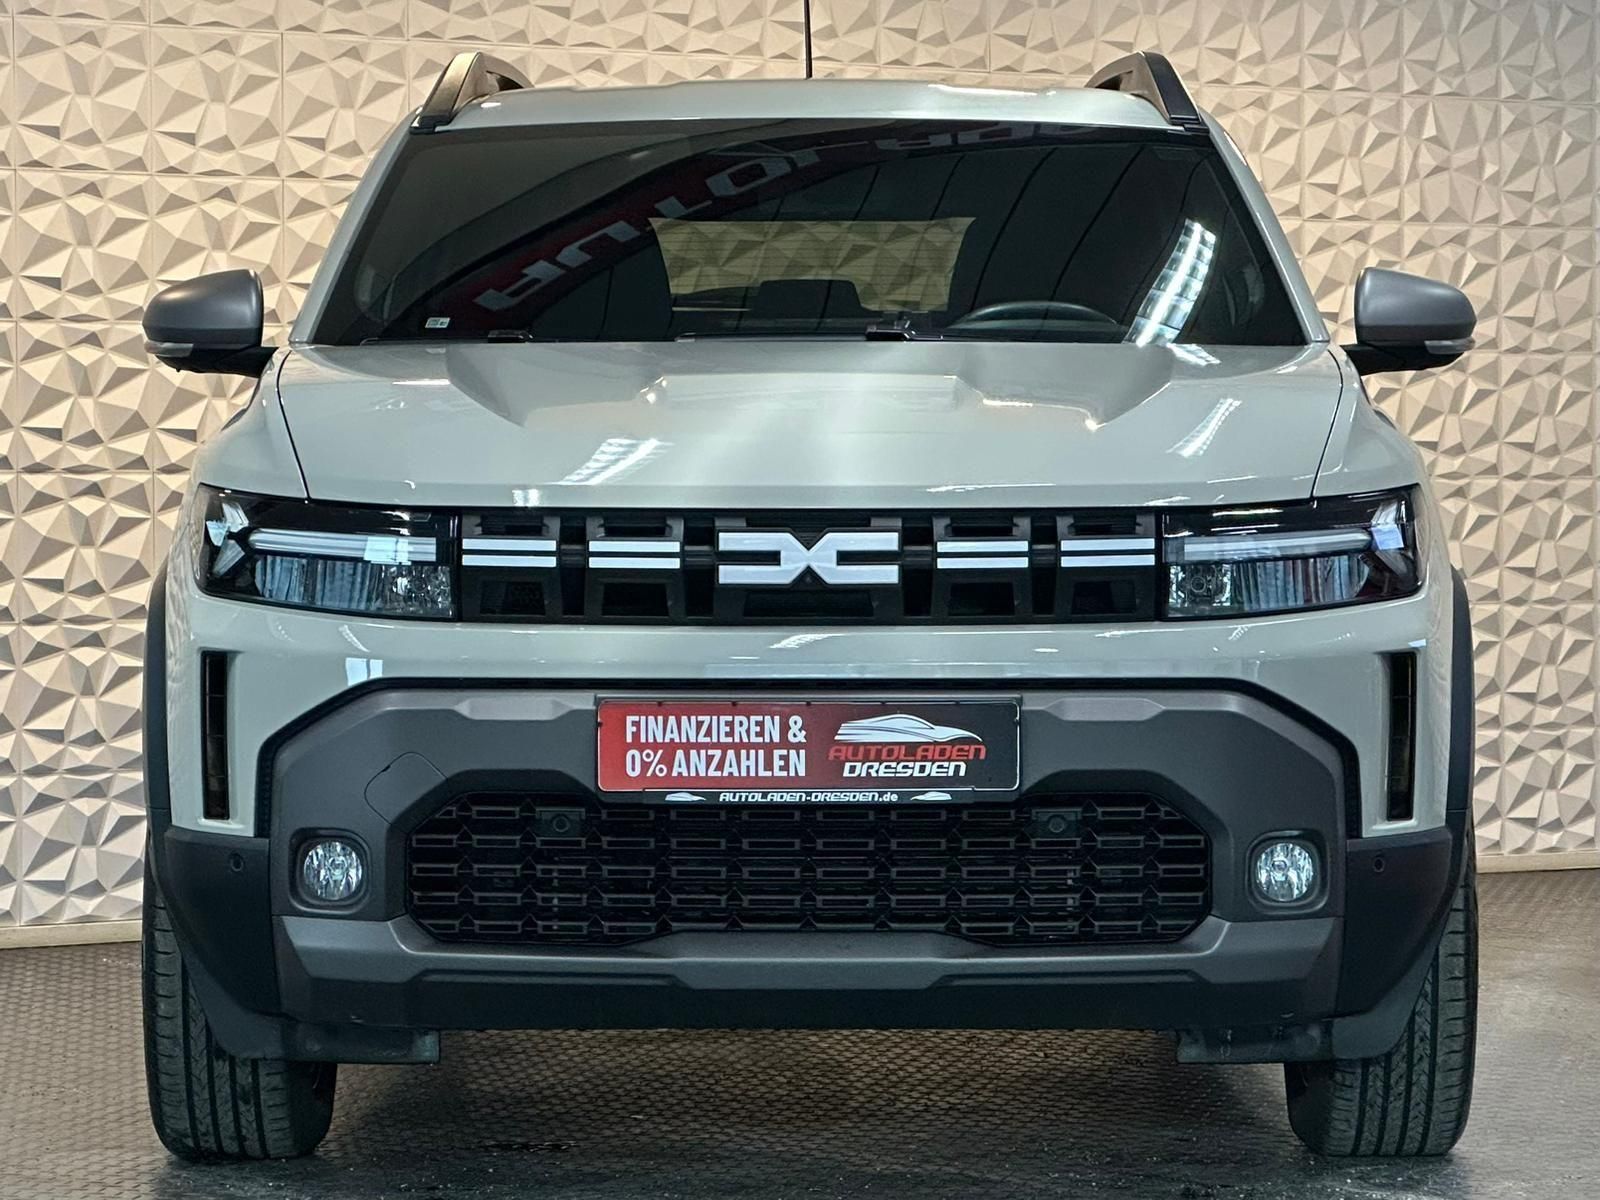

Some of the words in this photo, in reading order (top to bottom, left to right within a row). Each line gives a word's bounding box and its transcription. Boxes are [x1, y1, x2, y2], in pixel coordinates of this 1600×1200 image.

[626, 715, 780, 743] FINANZIEREN
[787, 715, 807, 743] &
[626, 749, 668, 777] 0%
[671, 749, 806, 777] ANZAHLEN
[828, 744, 987, 761] AUTOLADEN
[842, 761, 967, 778] DRESDEN
